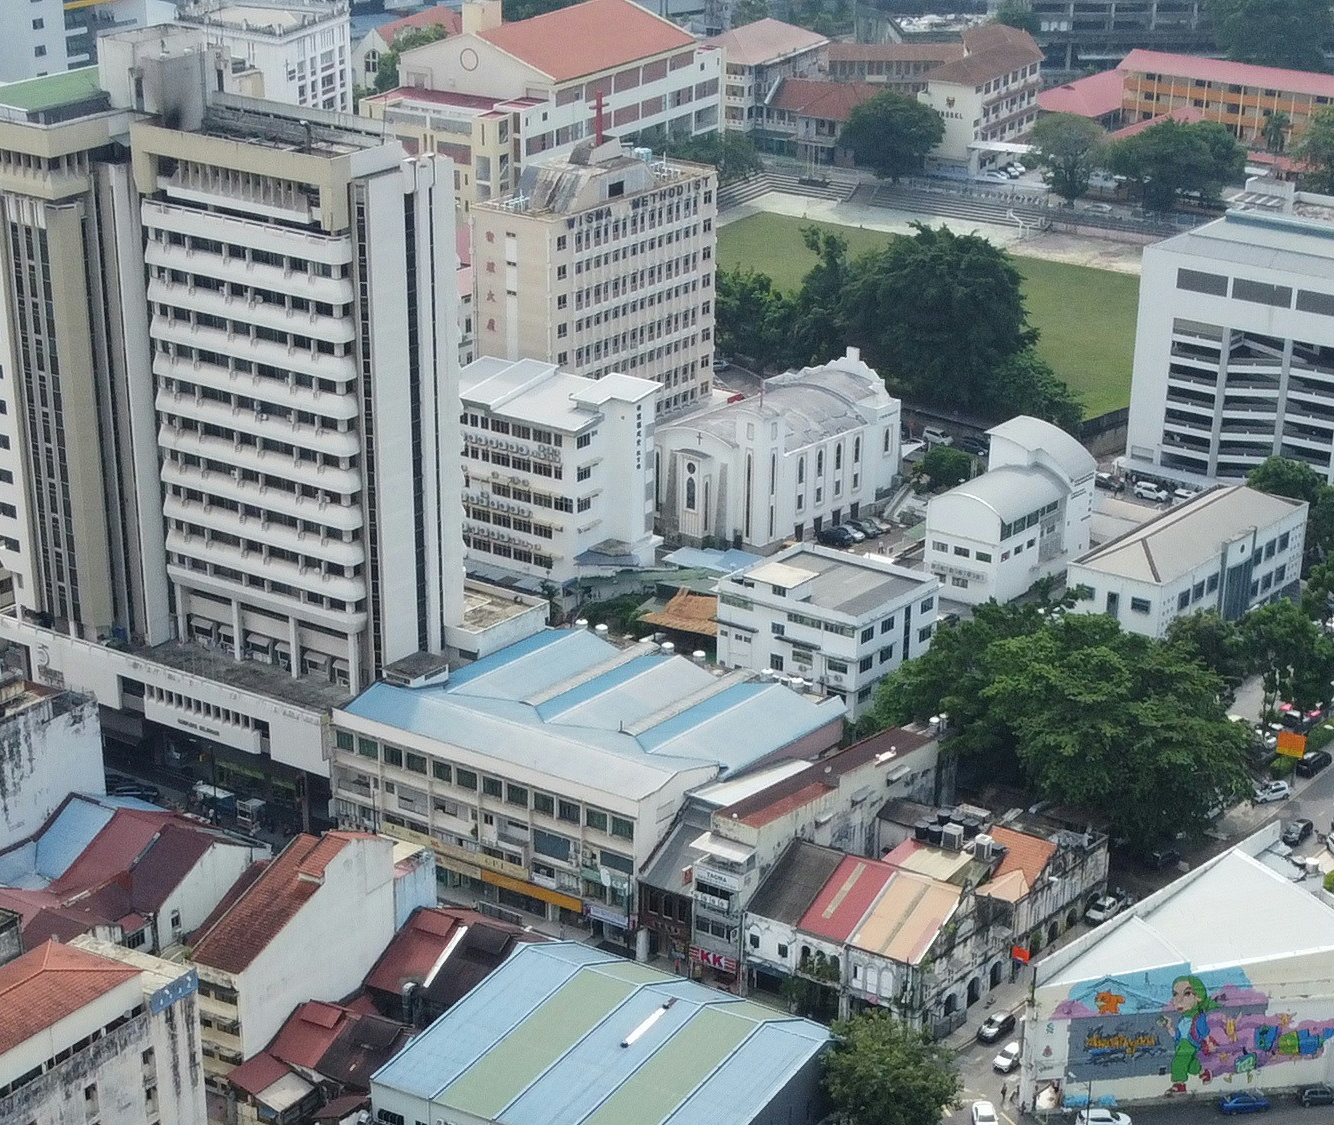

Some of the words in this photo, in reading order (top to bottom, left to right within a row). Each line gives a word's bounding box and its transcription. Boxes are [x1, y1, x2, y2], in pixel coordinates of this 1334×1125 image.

[566, 207, 613, 230] WISMA
[630, 176, 712, 211] METHODIST
[700, 948, 724, 969] KK
